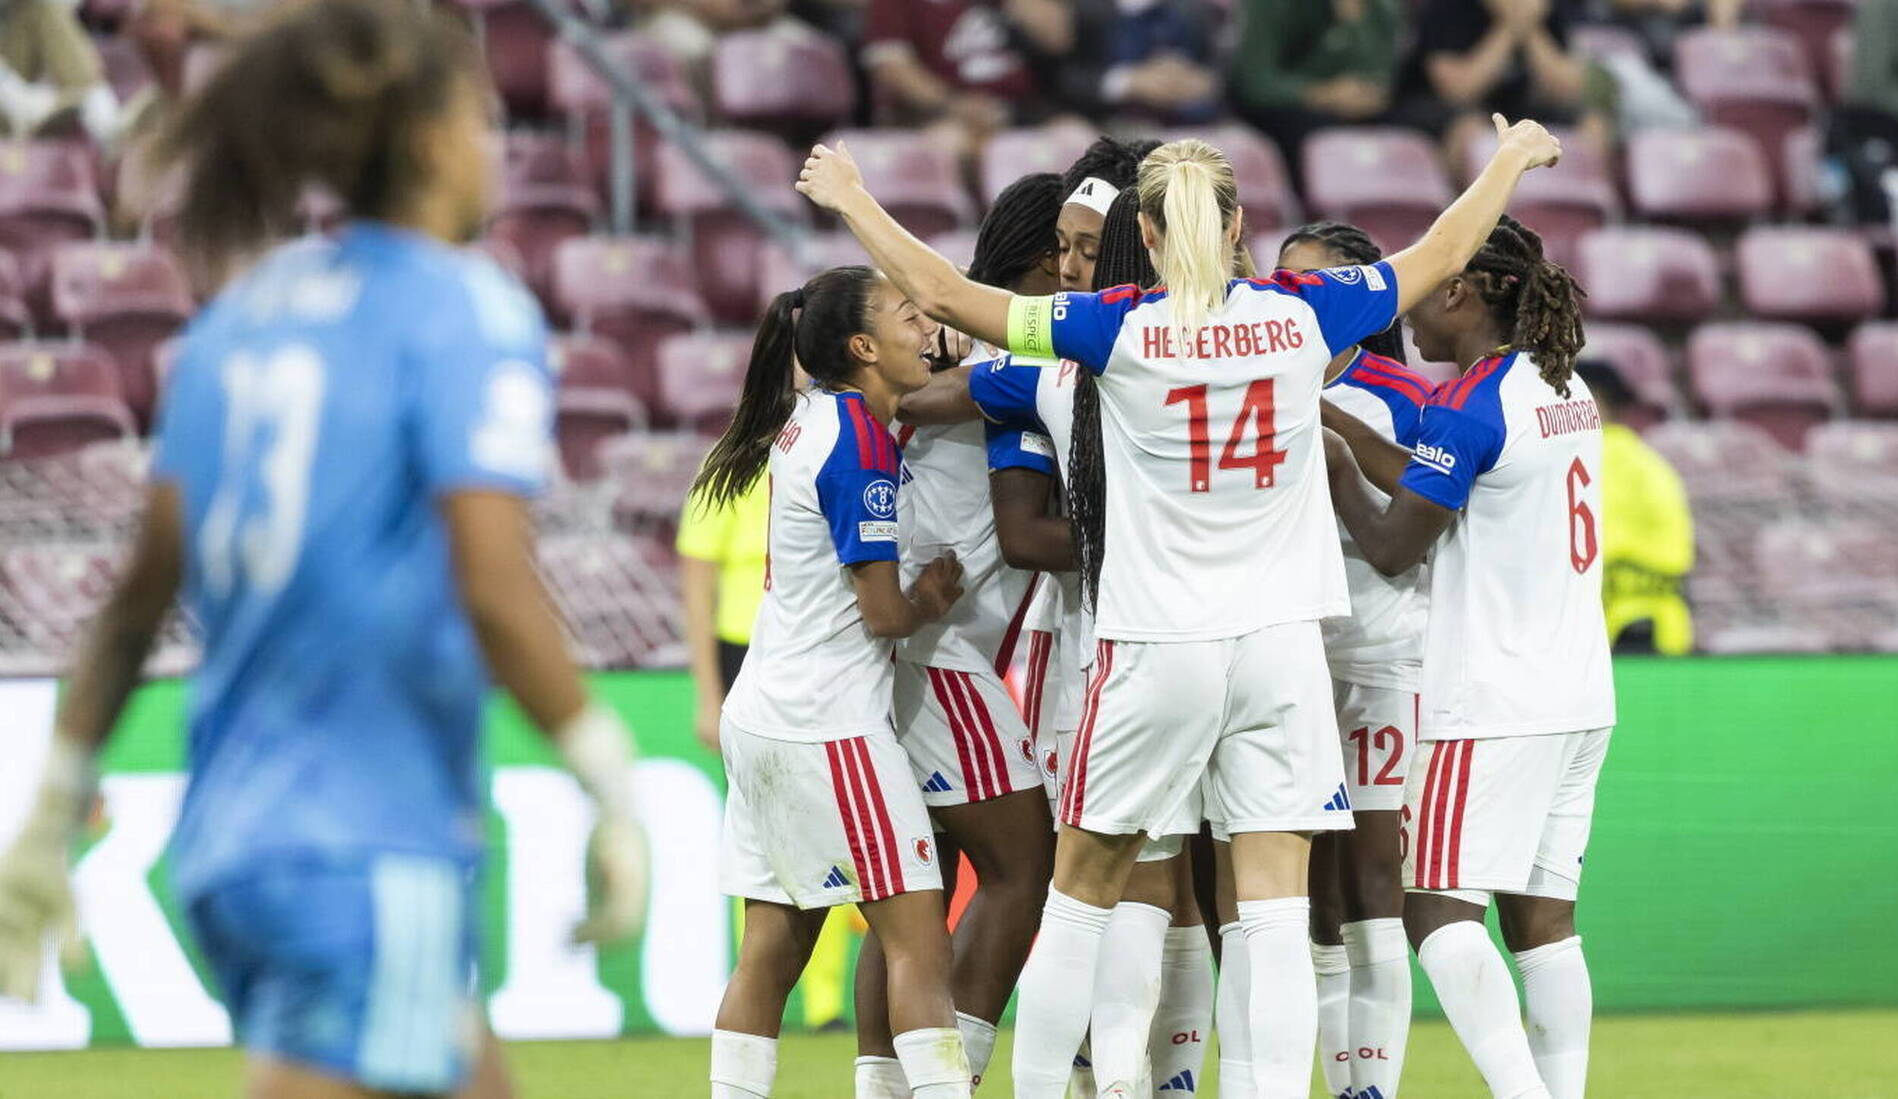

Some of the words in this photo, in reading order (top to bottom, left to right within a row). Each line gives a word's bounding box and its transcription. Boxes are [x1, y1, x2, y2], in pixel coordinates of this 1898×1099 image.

[1027, 304, 1038, 353] RESPECT
[1164, 376, 1289, 493] 14
[1566, 456, 1598, 575] 6
[1348, 724, 1405, 787] 12
[1172, 1029, 1201, 1046] OL
[1358, 1046, 1389, 1060] OL
